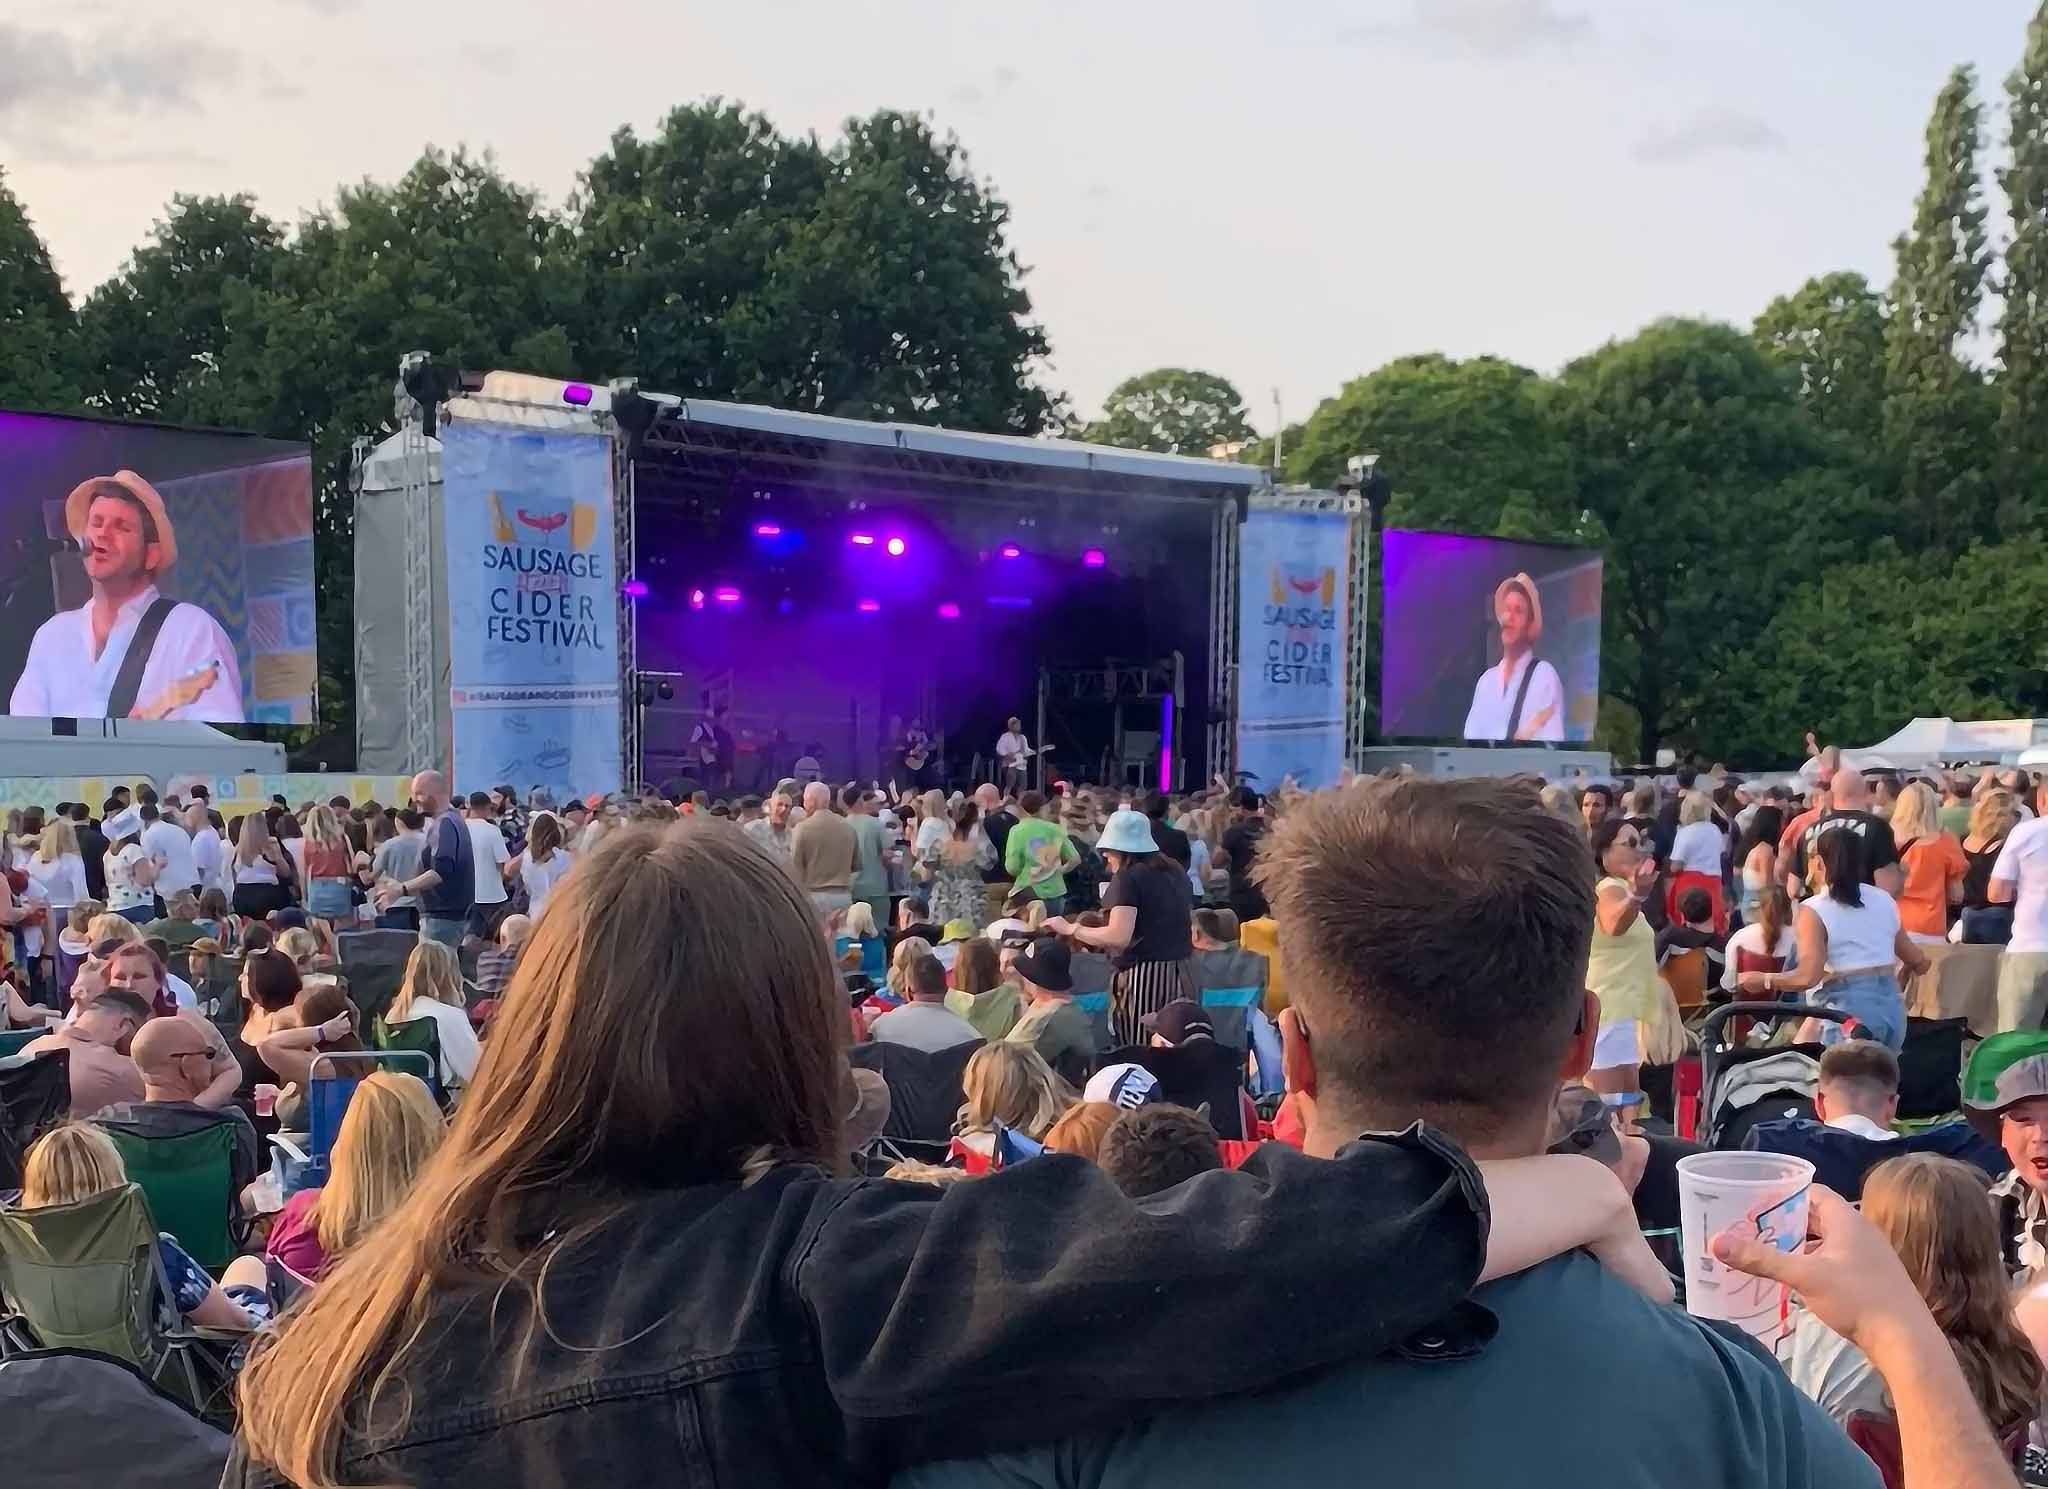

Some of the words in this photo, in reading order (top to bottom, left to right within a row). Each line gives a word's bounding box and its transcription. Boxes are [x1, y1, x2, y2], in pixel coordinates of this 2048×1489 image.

[483, 544, 602, 579] SAUSAGE
[490, 587, 594, 621] CIDER
[1263, 604, 1335, 630] SAUSAGE
[487, 615, 605, 651] FESTIVAL
[1267, 639, 1331, 664] CIDER
